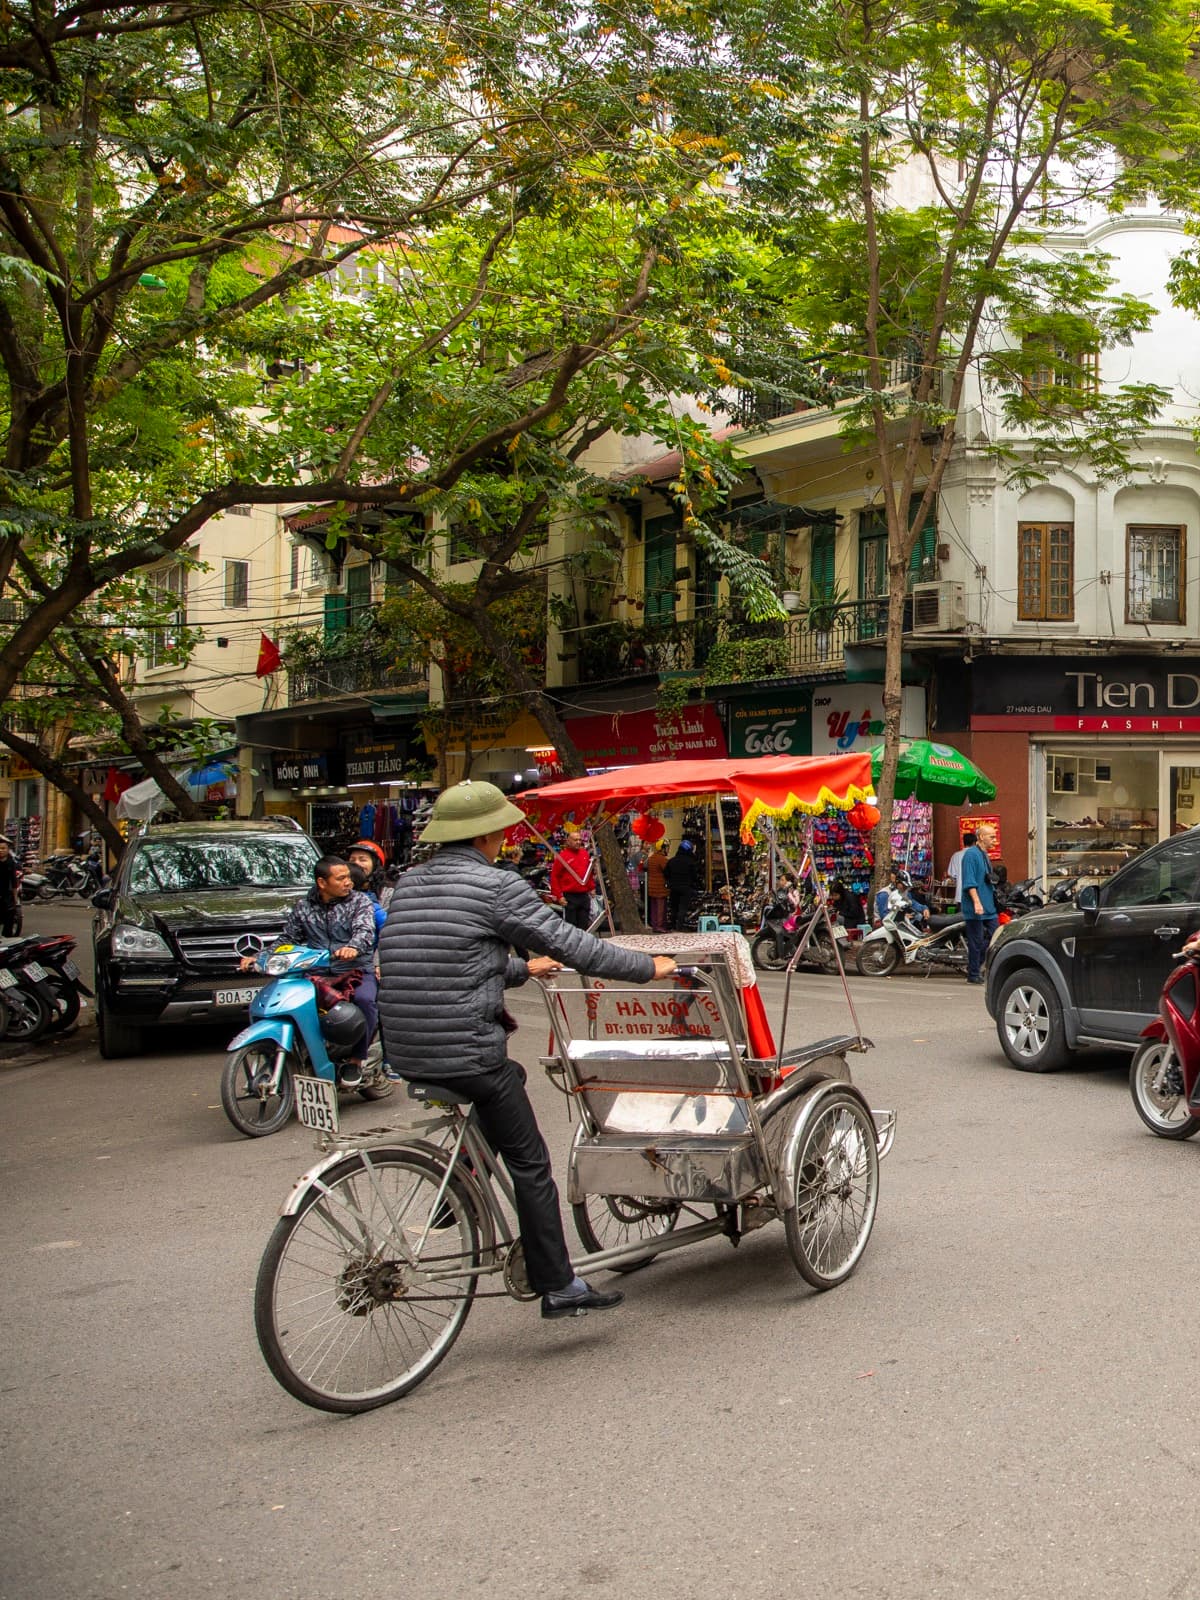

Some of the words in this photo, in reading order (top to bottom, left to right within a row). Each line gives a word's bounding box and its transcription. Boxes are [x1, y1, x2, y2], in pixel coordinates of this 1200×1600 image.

[1065, 671, 1155, 708] Tien
[814, 698, 832, 706] SHOP
[1006, 705, 1014, 713] 27
[1037, 705, 1051, 713] DAU
[346, 763, 375, 776] THANH
[616, 997, 647, 1016] HÀ
[299, 1081, 330, 1105] 29XL
[302, 1104, 334, 1131] 0095
